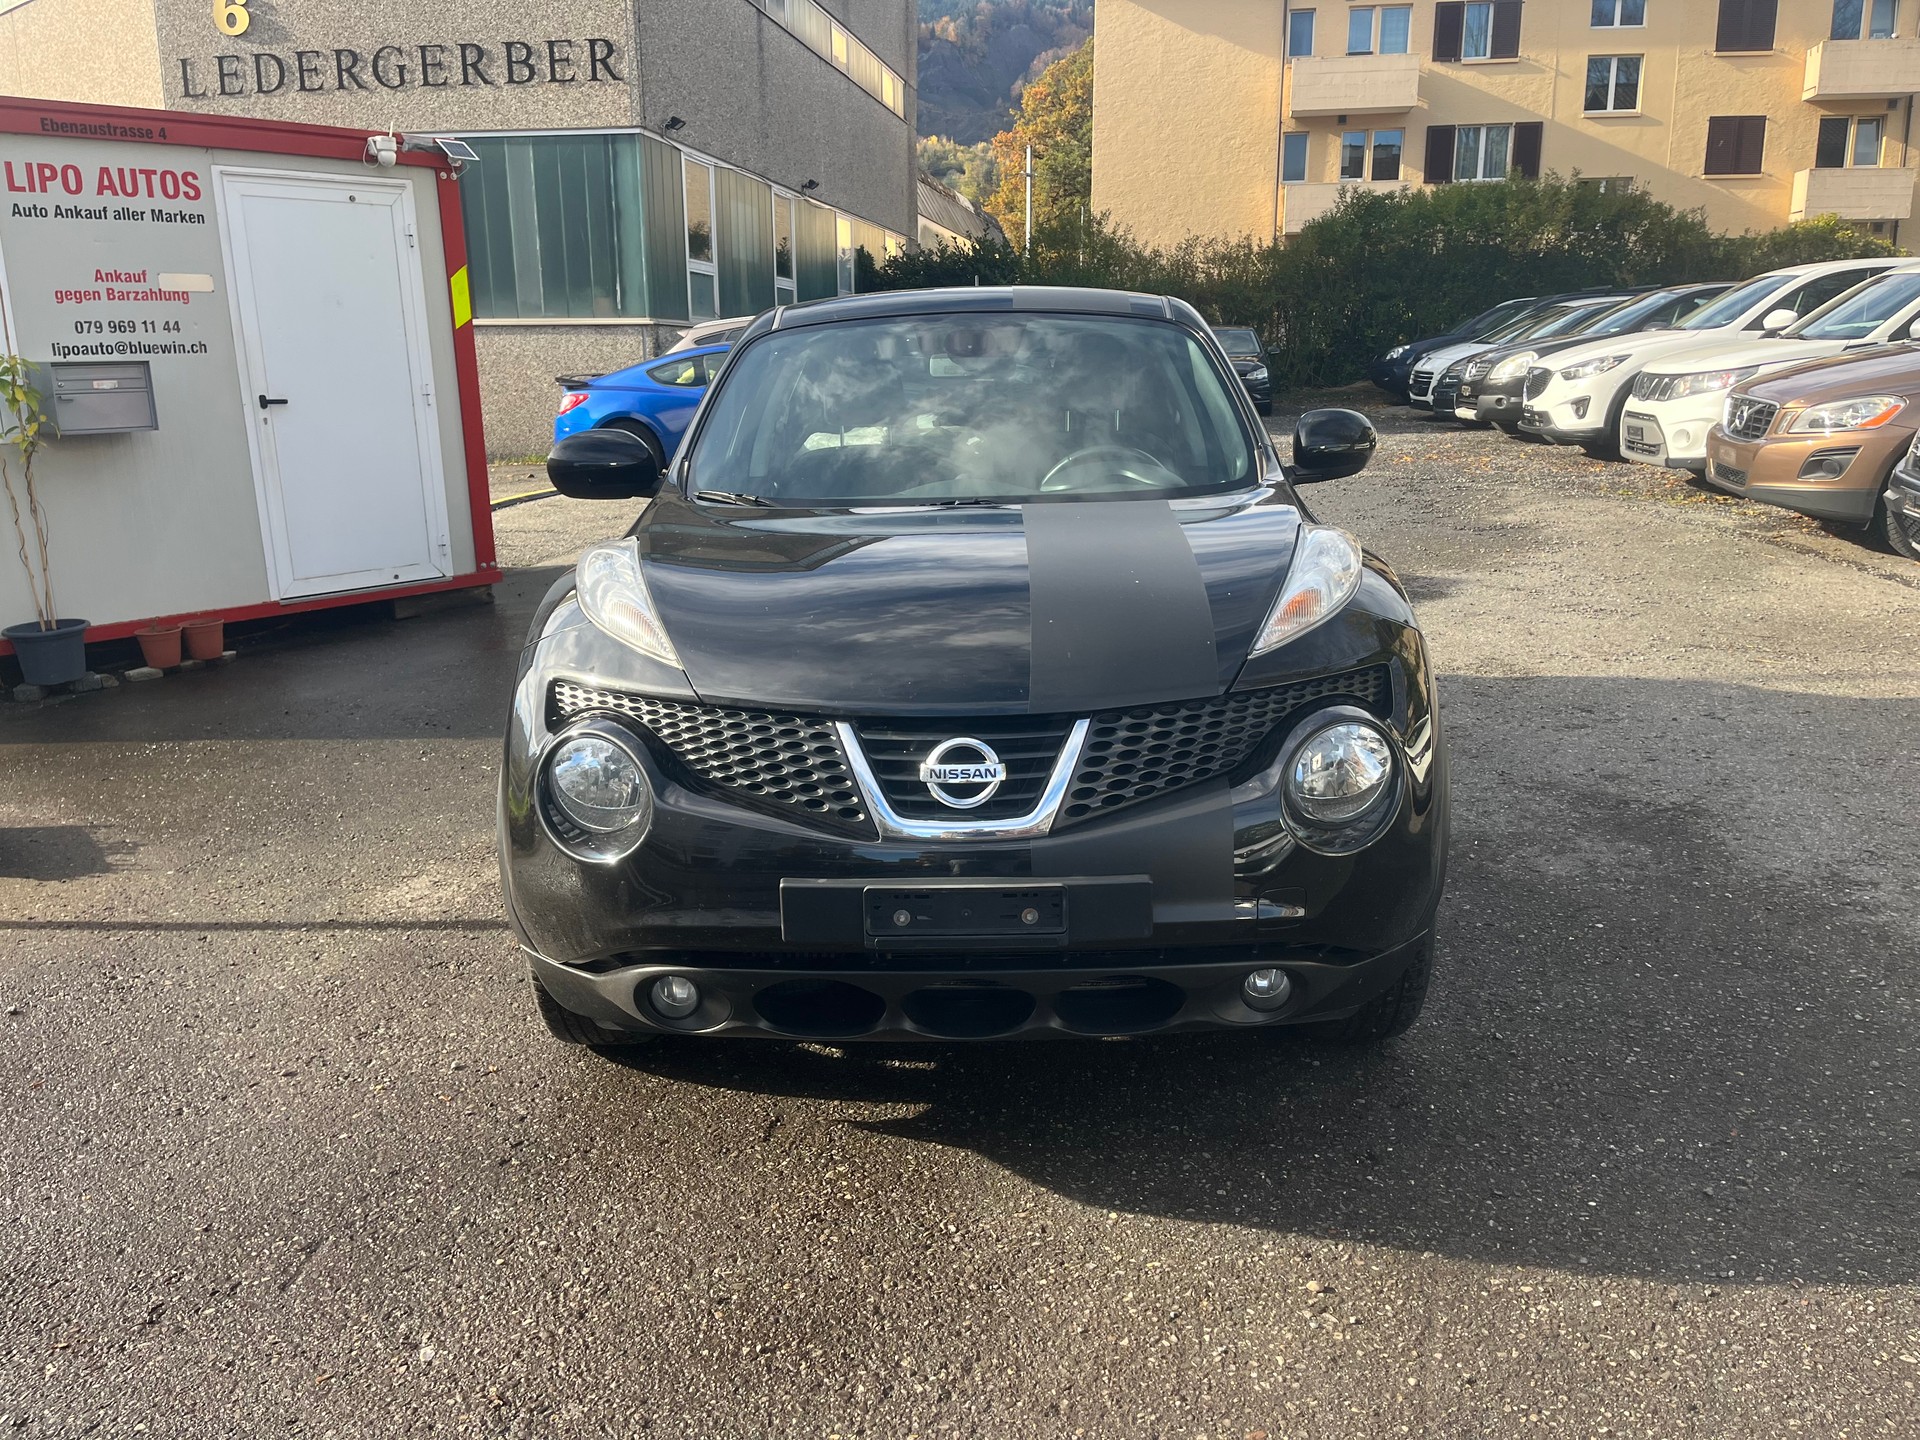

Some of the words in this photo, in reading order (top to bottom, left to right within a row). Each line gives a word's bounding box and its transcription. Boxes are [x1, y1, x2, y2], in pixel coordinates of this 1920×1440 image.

[211, 0, 251, 36] 6
[179, 38, 624, 98] LEDERGERBER
[40, 117, 154, 140] Ebenaustrasse
[158, 127, 168, 140] 4
[3, 160, 84, 196] LIPO
[96, 166, 202, 201] AUTOS
[11, 202, 48, 219] Auto
[54, 204, 108, 220] Ankauf
[113, 206, 146, 222] aller
[151, 208, 206, 225] Marken
[94, 269, 147, 284] Ankauf
[54, 289, 102, 304] gegen
[105, 287, 190, 305] Barzahlung
[74, 320, 104, 335] 079
[107, 320, 137, 334] 969
[141, 320, 156, 334] 11
[162, 320, 181, 334] 44
[51, 340, 208, 359] lipoauto@bluewin.ch
[928, 767, 998, 780] NISSAN
